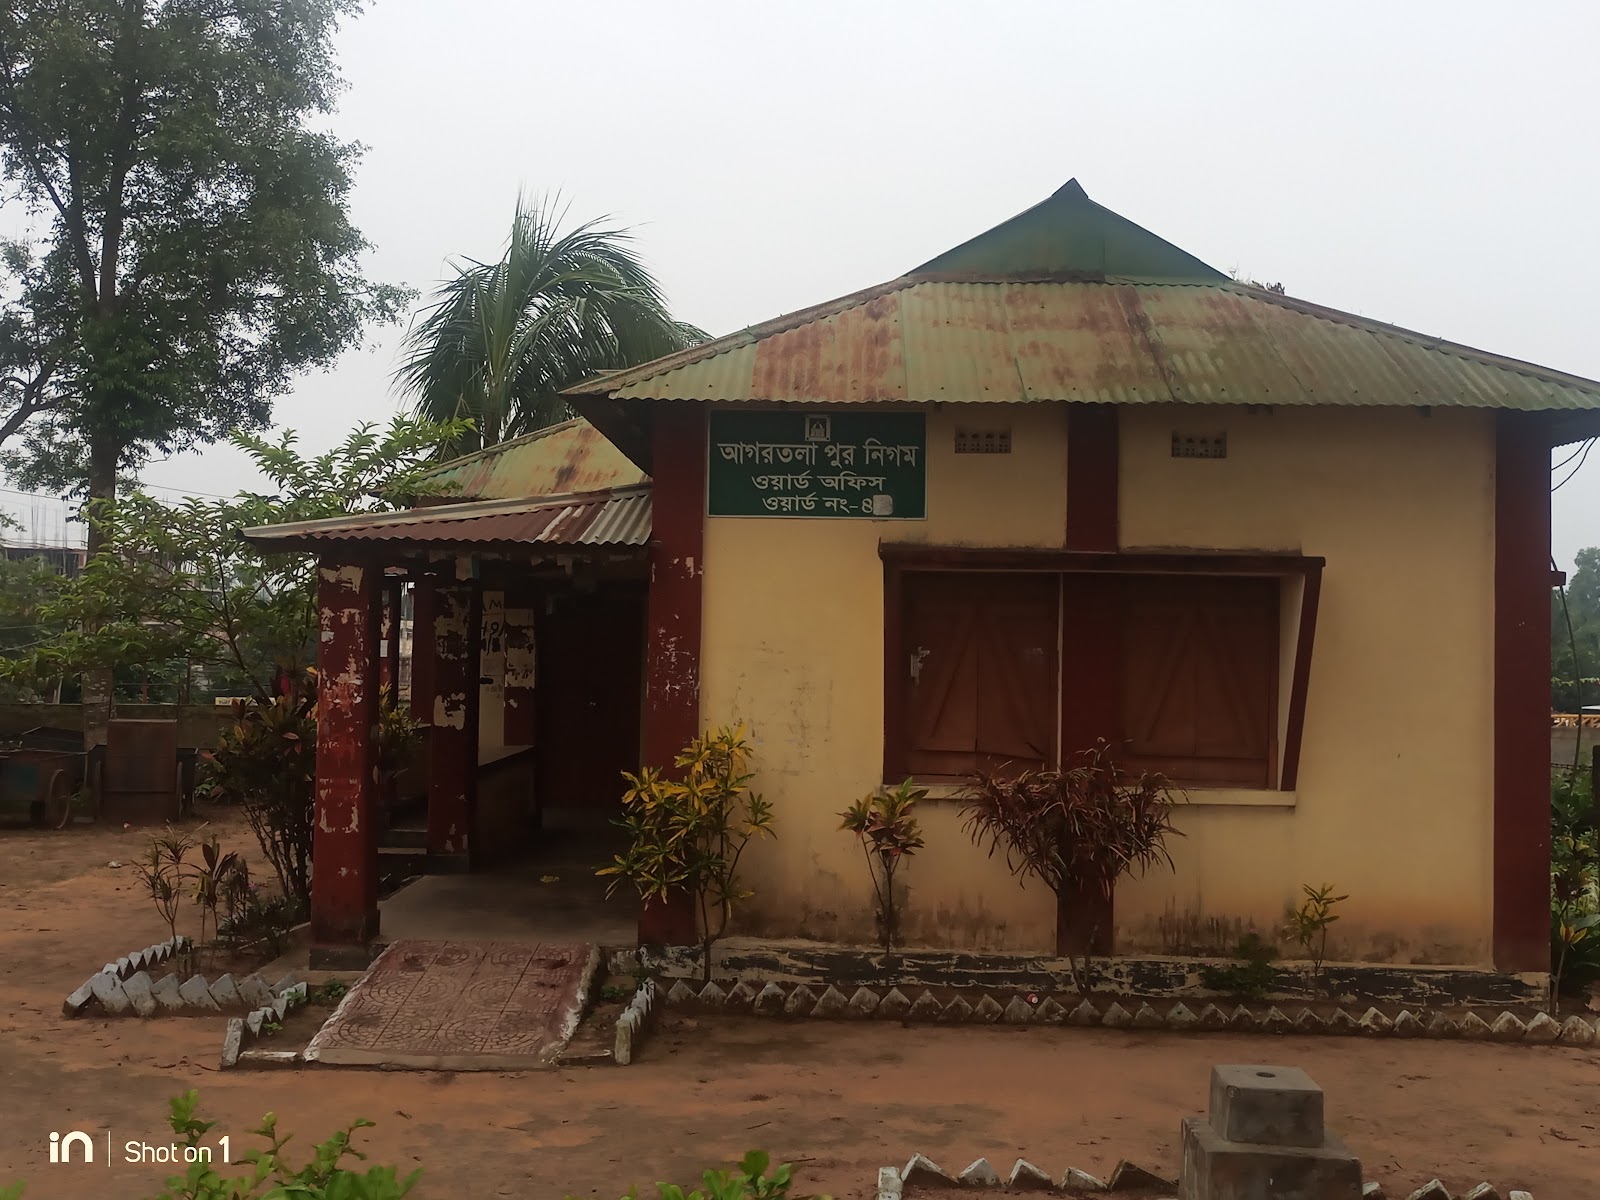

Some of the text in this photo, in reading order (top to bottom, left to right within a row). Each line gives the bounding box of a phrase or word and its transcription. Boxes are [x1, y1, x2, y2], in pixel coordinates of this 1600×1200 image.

[717, 438, 919, 469] আগরতলা পুর নিগম
[751, 470, 887, 492] ওয়ার্ড অফিস
[762, 492, 819, 512] ওয়ার্ড
